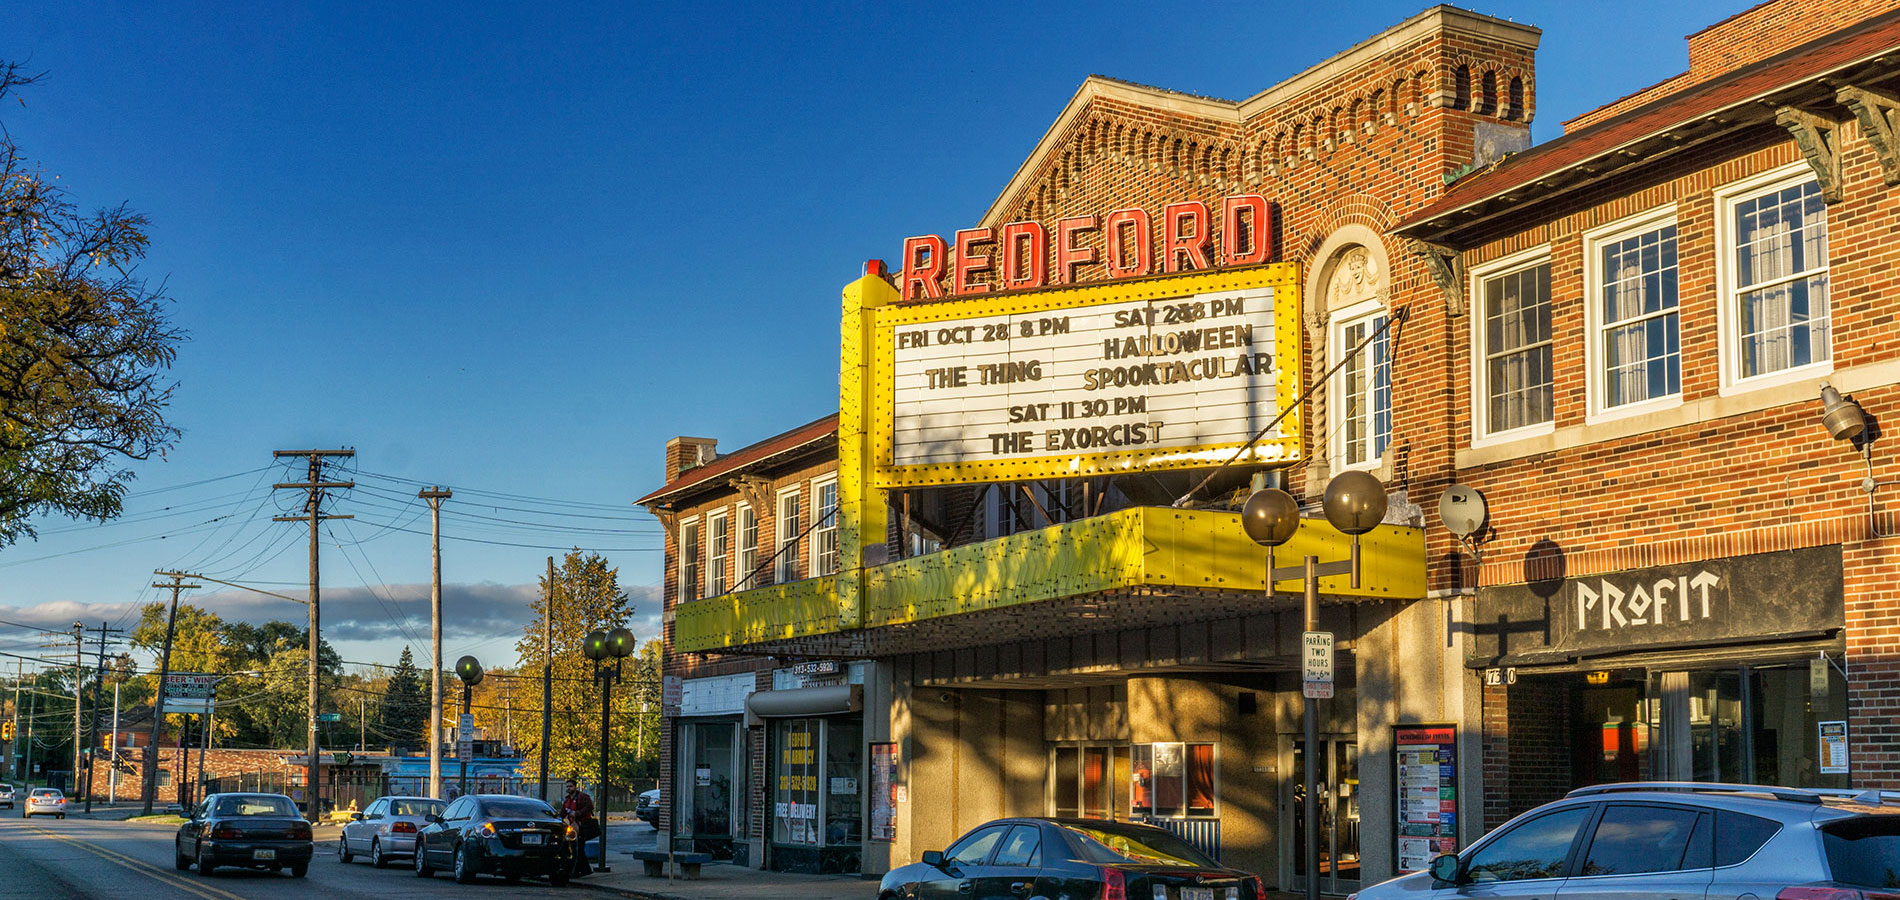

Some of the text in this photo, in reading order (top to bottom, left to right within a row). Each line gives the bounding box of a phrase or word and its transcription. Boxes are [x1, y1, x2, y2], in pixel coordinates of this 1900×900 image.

[900, 193, 1273, 299] REDFORD
[1114, 306, 1160, 328] SAT
[1211, 297, 1244, 318] PM
[899, 316, 1070, 349] FRI OCT 28 8 PM
[1104, 324, 1253, 360] HALLOWEEN
[925, 360, 1042, 389] THE THING
[1083, 353, 1272, 391] SPOOKTACULAR
[1009, 403, 1050, 423] SAT
[1081, 399, 1108, 418] 30
[1114, 395, 1146, 415] PM
[988, 421, 1164, 455] THE EXORCIST
[1577, 570, 1720, 630] PROFIT
[1305, 637, 1331, 646] PARKING
[1311, 648, 1326, 657] TWO
[794, 662, 833, 675] 313-532-5920
[1308, 659, 1328, 667] HOURS
[776, 802, 788, 817] FREE
